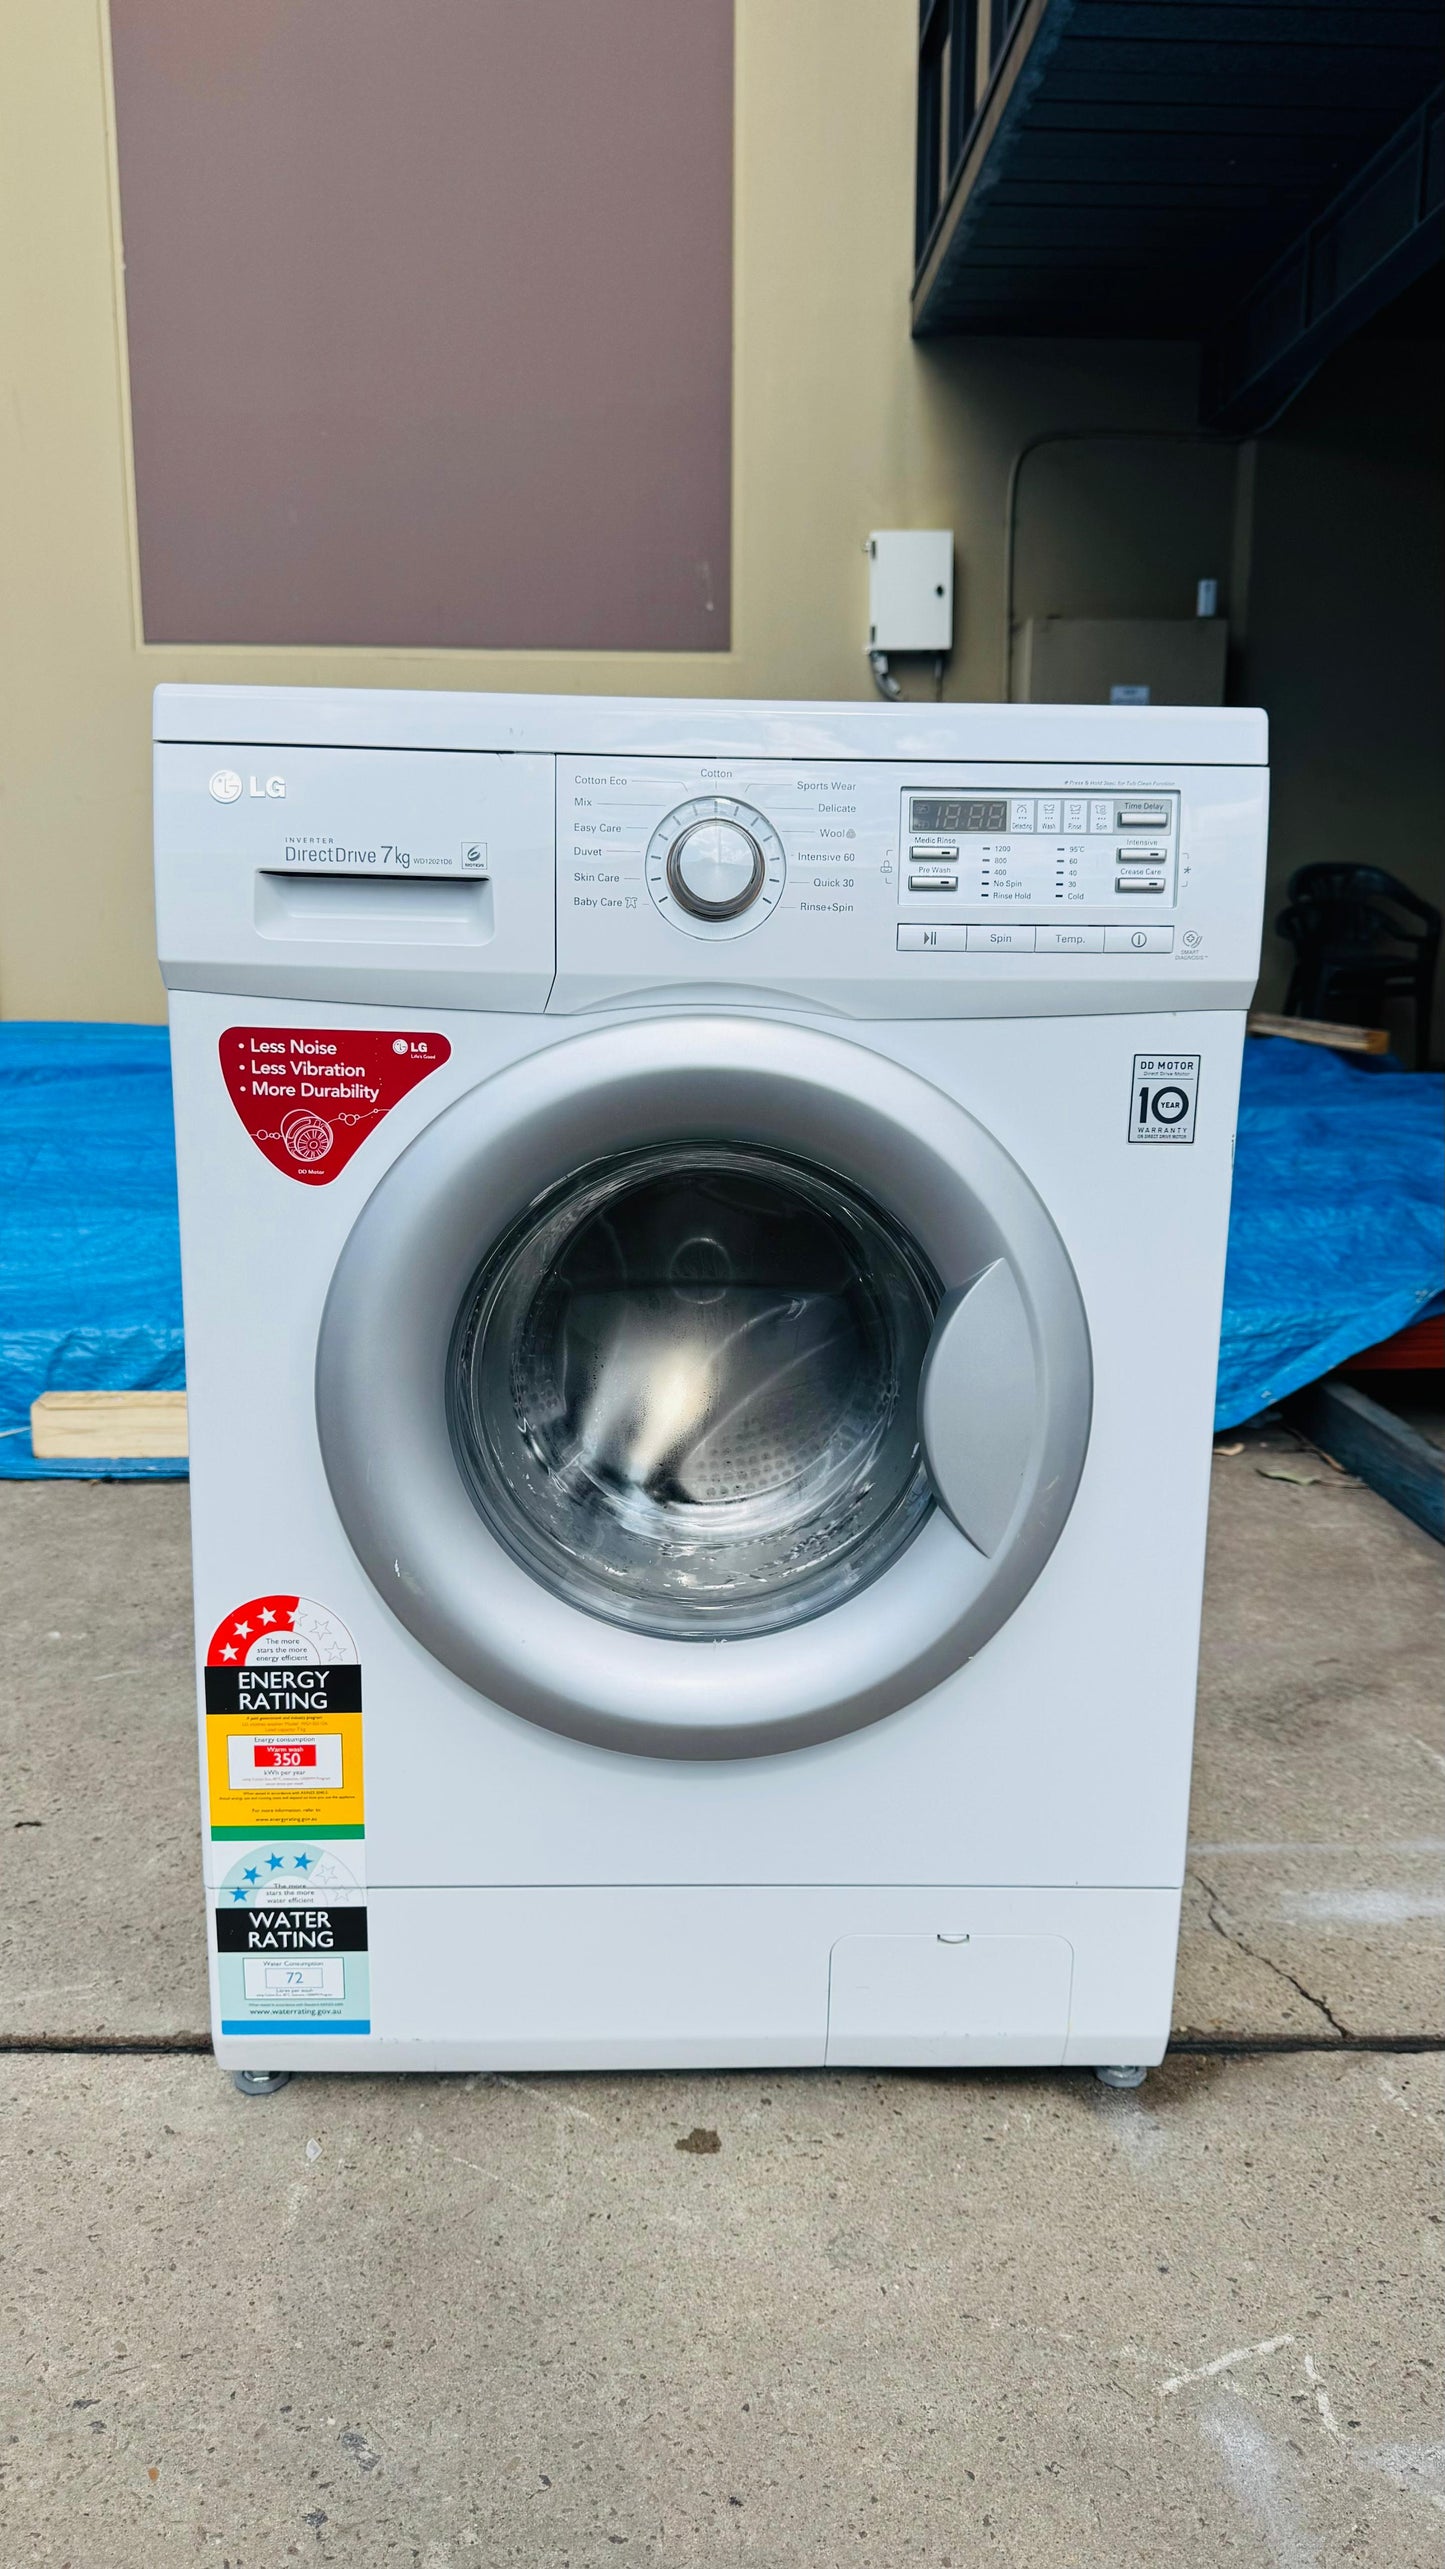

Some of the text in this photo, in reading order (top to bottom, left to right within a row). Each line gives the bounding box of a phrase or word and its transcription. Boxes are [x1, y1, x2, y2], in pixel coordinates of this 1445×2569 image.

[700, 769, 732, 778] Cotton
[574, 776, 628, 786] Cotton Eco
[797, 781, 856, 792] Sports Wear
[250, 776, 286, 798] LG
[574, 797, 592, 806] Mix
[1124, 802, 1142, 810] Time
[818, 803, 856, 813] Delicate
[574, 823, 622, 834] Easy Care
[1096, 823, 1107, 831] Spin
[820, 829, 845, 838] Wool
[574, 847, 602, 856] Duvet
[798, 852, 855, 862] Intensive 60
[574, 873, 620, 882] Skin Care
[1120, 868, 1143, 876] Crease
[813, 878, 854, 889] Quick 30
[1006, 880, 1022, 889] Spin
[993, 892, 1032, 900] Rinse Hold
[1067, 892, 1084, 900] Cold
[574, 897, 622, 908] Baby Care
[800, 902, 854, 913] Rinse+Spin
[990, 933, 1012, 944] Spin
[1056, 934, 1086, 945] Temp.
[250, 1038, 337, 1055] Less Noise
[411, 1042, 428, 1053] LG
[252, 1060, 365, 1078] Less Vibration
[1140, 1061, 1194, 1070] DD MOTOR
[252, 1081, 379, 1102] More Durability
[1139, 1086, 1189, 1124] 10
[238, 1670, 330, 1690] ENERGY
[239, 1692, 328, 1711] RATING
[273, 1753, 301, 1766] 350
[249, 1912, 332, 1928] WATER
[248, 1930, 334, 1948] RATING
[286, 1972, 304, 1984] 72
[250, 2007, 342, 2016] www.waterrating.gov.au
